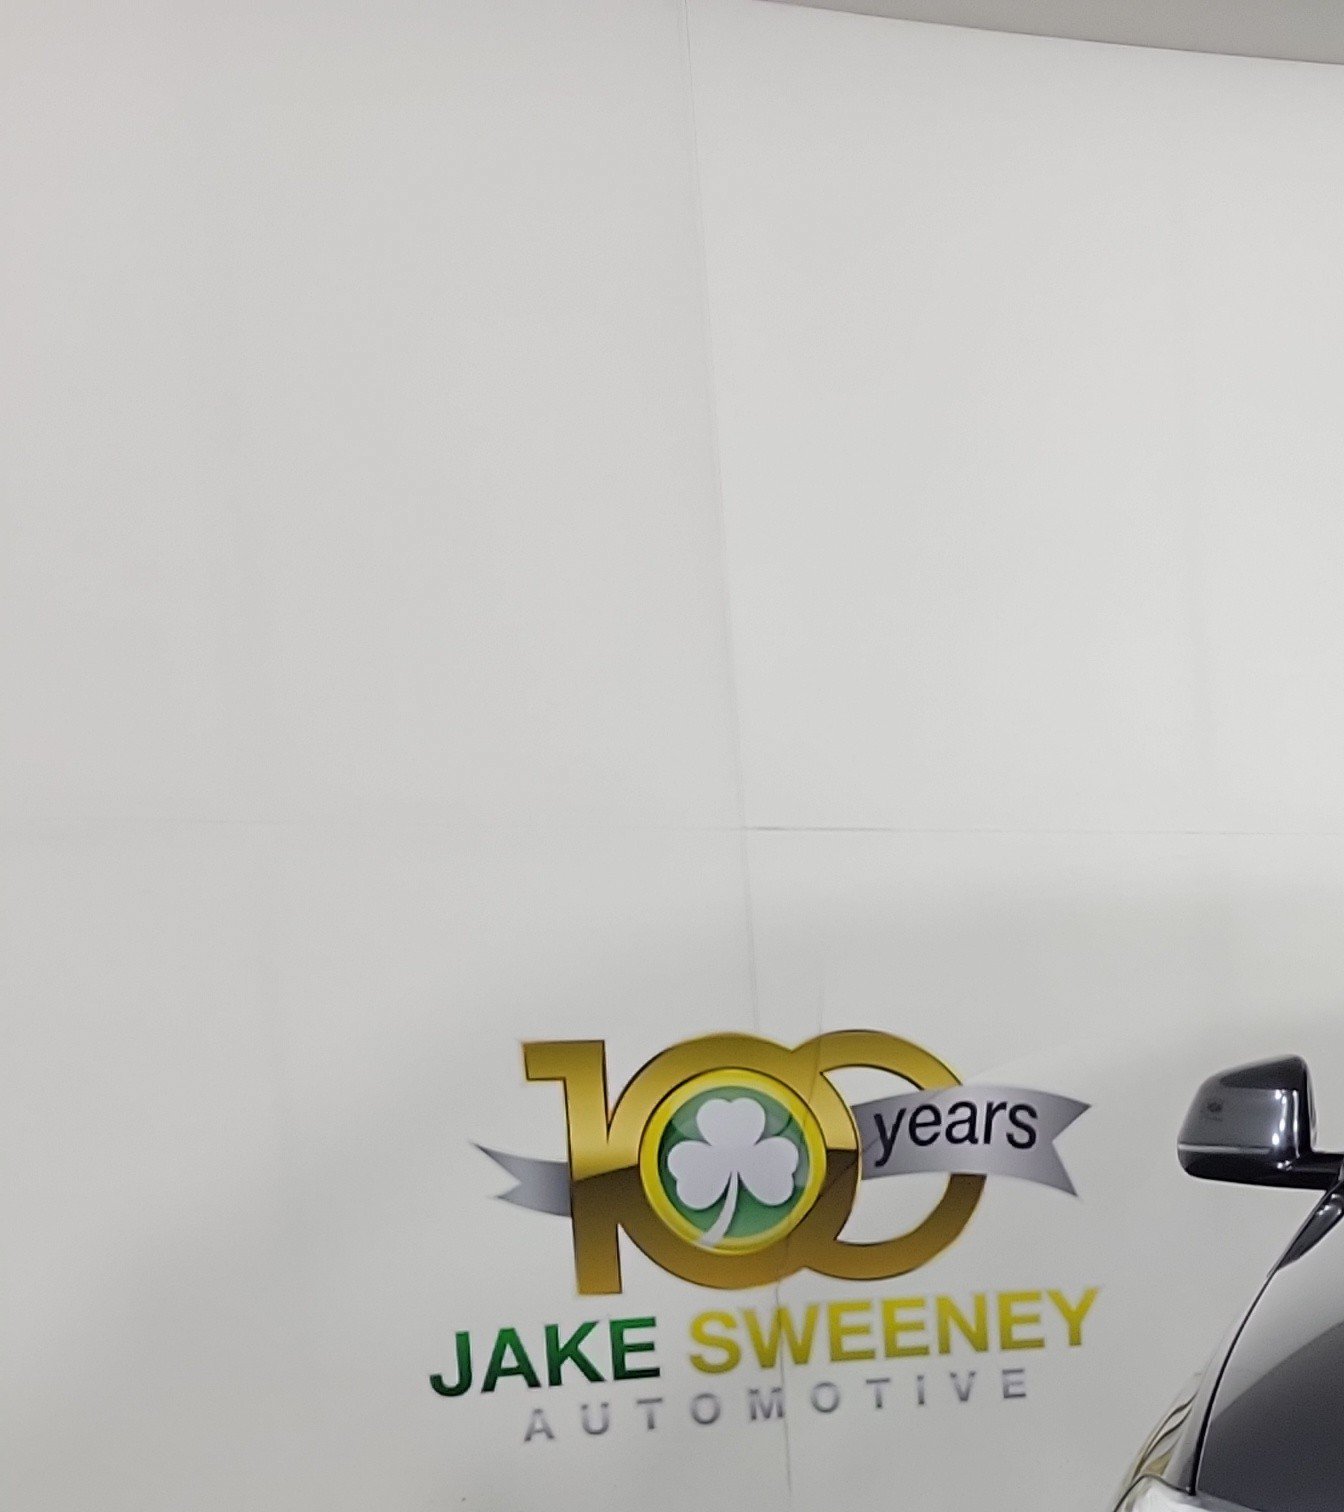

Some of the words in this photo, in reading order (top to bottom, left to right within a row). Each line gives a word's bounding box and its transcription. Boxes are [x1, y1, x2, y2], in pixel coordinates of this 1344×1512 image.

[520, 1029, 988, 1295] 100
[872, 1099, 1039, 1169] years
[428, 1315, 661, 1400] JAKE
[687, 1286, 1102, 1375] SWEENEY
[523, 1368, 1029, 1445] AUTOMOTIVE
